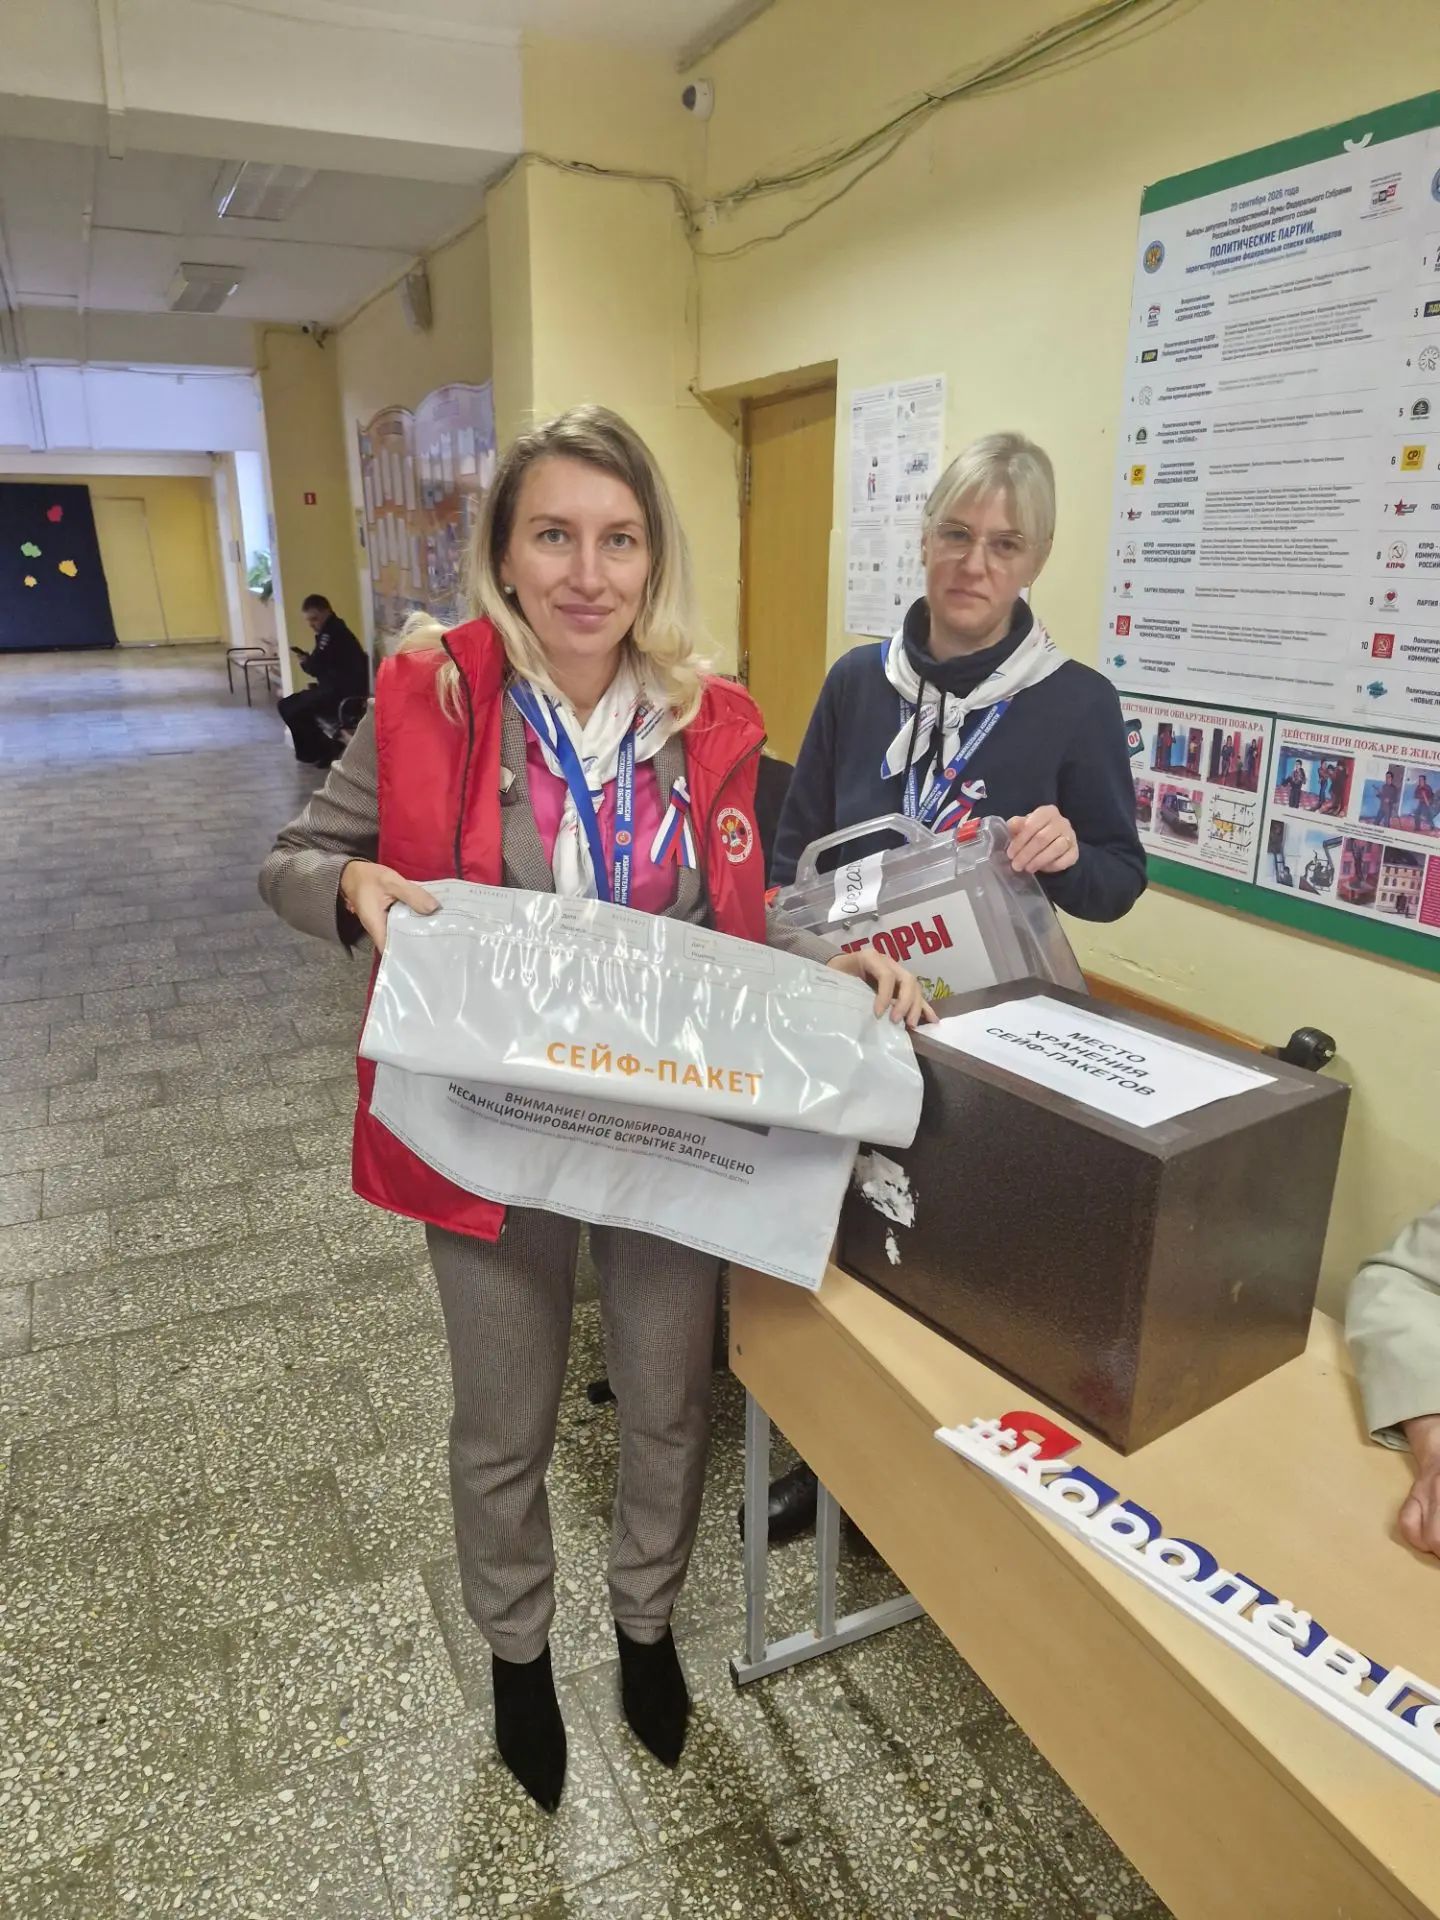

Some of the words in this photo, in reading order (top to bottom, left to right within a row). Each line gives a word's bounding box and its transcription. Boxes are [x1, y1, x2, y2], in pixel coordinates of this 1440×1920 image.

[1228, 208, 1269, 226] Государственной
[1269, 205, 1285, 216] Думы
[1285, 196, 1324, 210] Федерального
[1325, 186, 1353, 201] Собрания
[1239, 195, 1266, 210] сентября
[1267, 188, 1283, 201] 2026
[1284, 186, 1300, 198] года
[1209, 230, 1276, 257] ПОЛИТИЧЕСКИЕ
[1277, 220, 1315, 241] ПАРТИИ,
[1212, 226, 1241, 241] Российской
[1241, 219, 1271, 234] Федерации
[1271, 212, 1296, 226] девятого
[1296, 207, 1317, 218] созыва
[1282, 239, 1305, 251] списки
[1305, 229, 1342, 246] кандидатов
[1413, 308, 1419, 318] 3
[1406, 358, 1411, 368] 4
[1398, 408, 1404, 417] 5
[1391, 456, 1396, 465] 6
[1376, 551, 1382, 560] 8
[1369, 596, 1375, 606] 9
[1417, 599, 1439, 607] ПАРТИЯ
[1361, 641, 1369, 650] 10
[1356, 685, 1362, 694] 11
[1121, 703, 1153, 714] ЕЙСТВИЯ
[1154, 708, 1170, 717] ПРИ
[1170, 709, 1228, 727] ОБНАРУЖЕНИИ
[1228, 718, 1264, 733] ПОЖАРА
[1281, 727, 1331, 744] ДЕЙСТВИЯ
[1331, 735, 1353, 748] ПРИ
[1353, 738, 1400, 755] ПОЖАРЕ
[1400, 746, 1408, 755] В
[624, 791, 632, 822] КОМИССИЯ
[622, 855, 630, 904] ИЗБИРАТЕЛЬНАЯ
[986, 1027, 1156, 1096] СЕЙФ-ПАКЕТОВ
[1027, 1030, 1152, 1078] ХРАНЕНИЯ
[1067, 1032, 1147, 1064] МЕСТО
[547, 1042, 763, 1096] СЕЙФ-ПАКЕТ
[448, 1082, 612, 1138] НЕСАНКЦИОНИРОВАННОЕ
[614, 1131, 675, 1152] ВСКРЫТИЕ
[678, 1143, 755, 1175] ЗАПРЕЩЕНО
[505, 1092, 585, 1120] ВНИМАНИЕ!
[588, 1112, 706, 1146] ОПЛОМБИРОВАНО!
